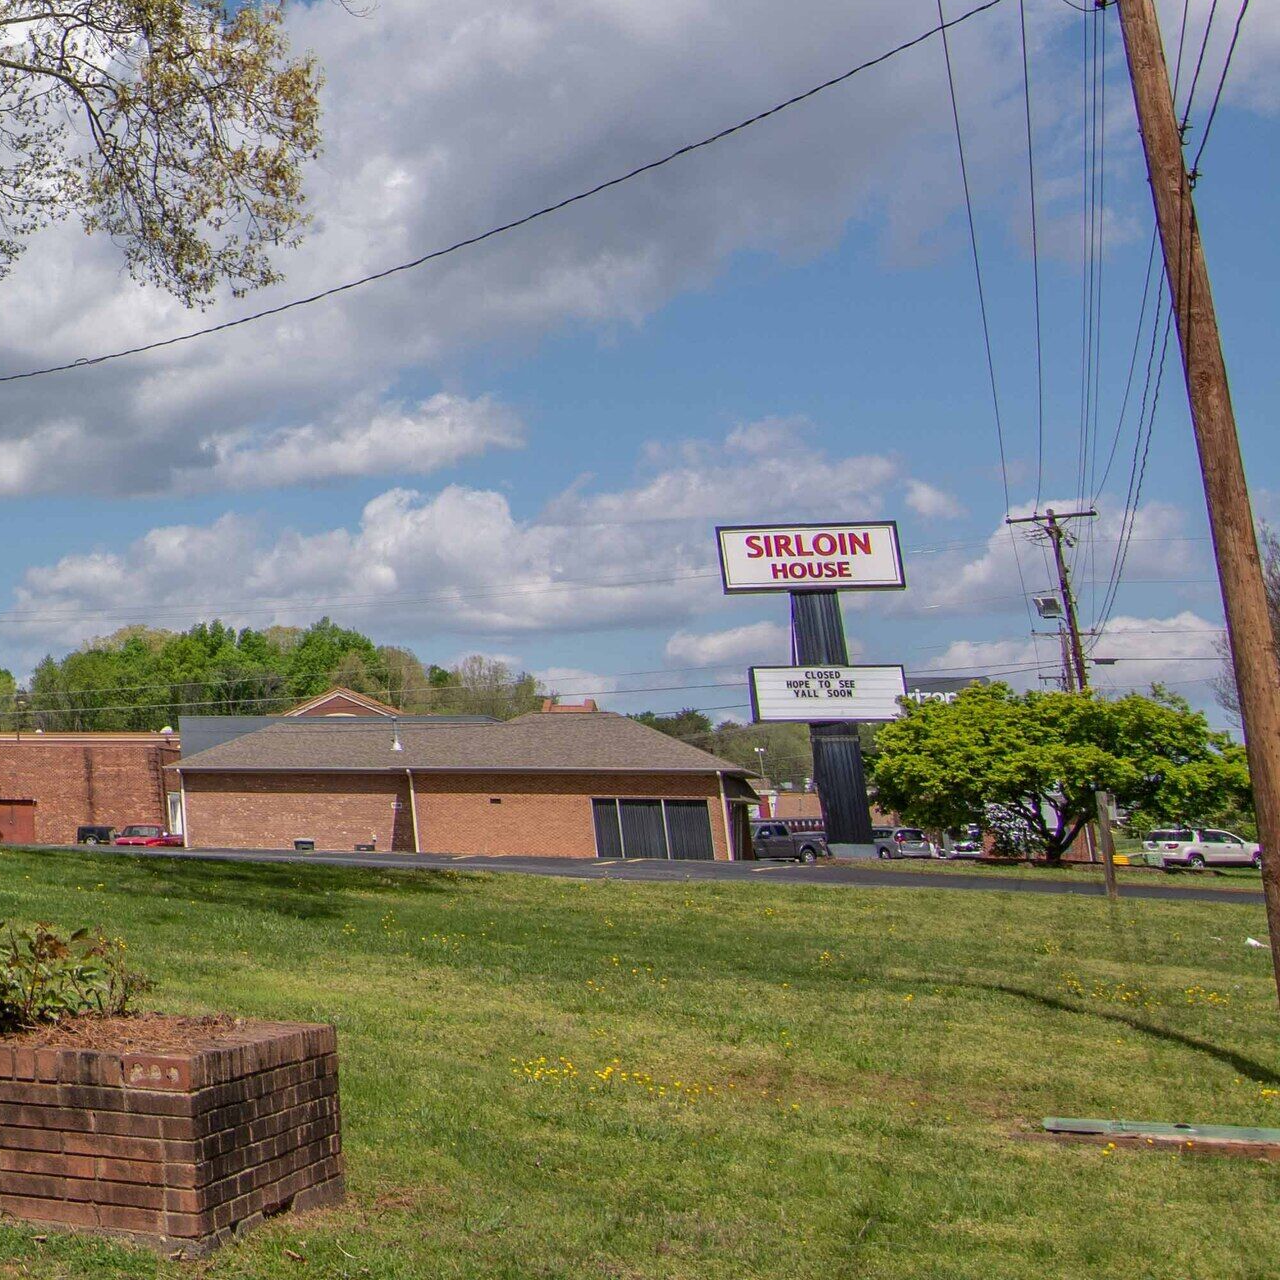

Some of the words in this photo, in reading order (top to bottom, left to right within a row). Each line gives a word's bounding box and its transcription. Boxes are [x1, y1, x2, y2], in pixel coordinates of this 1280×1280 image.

[745, 532, 872, 558] SIRLOIN
[771, 561, 852, 579] HOUSE
[804, 670, 841, 680] CLOSED
[786, 680, 811, 689] HOPE
[818, 680, 831, 689] TO
[838, 680, 856, 689] SEE
[793, 689, 819, 698] YALL
[826, 689, 853, 698] SOON
[906, 688, 958, 704] rizon
